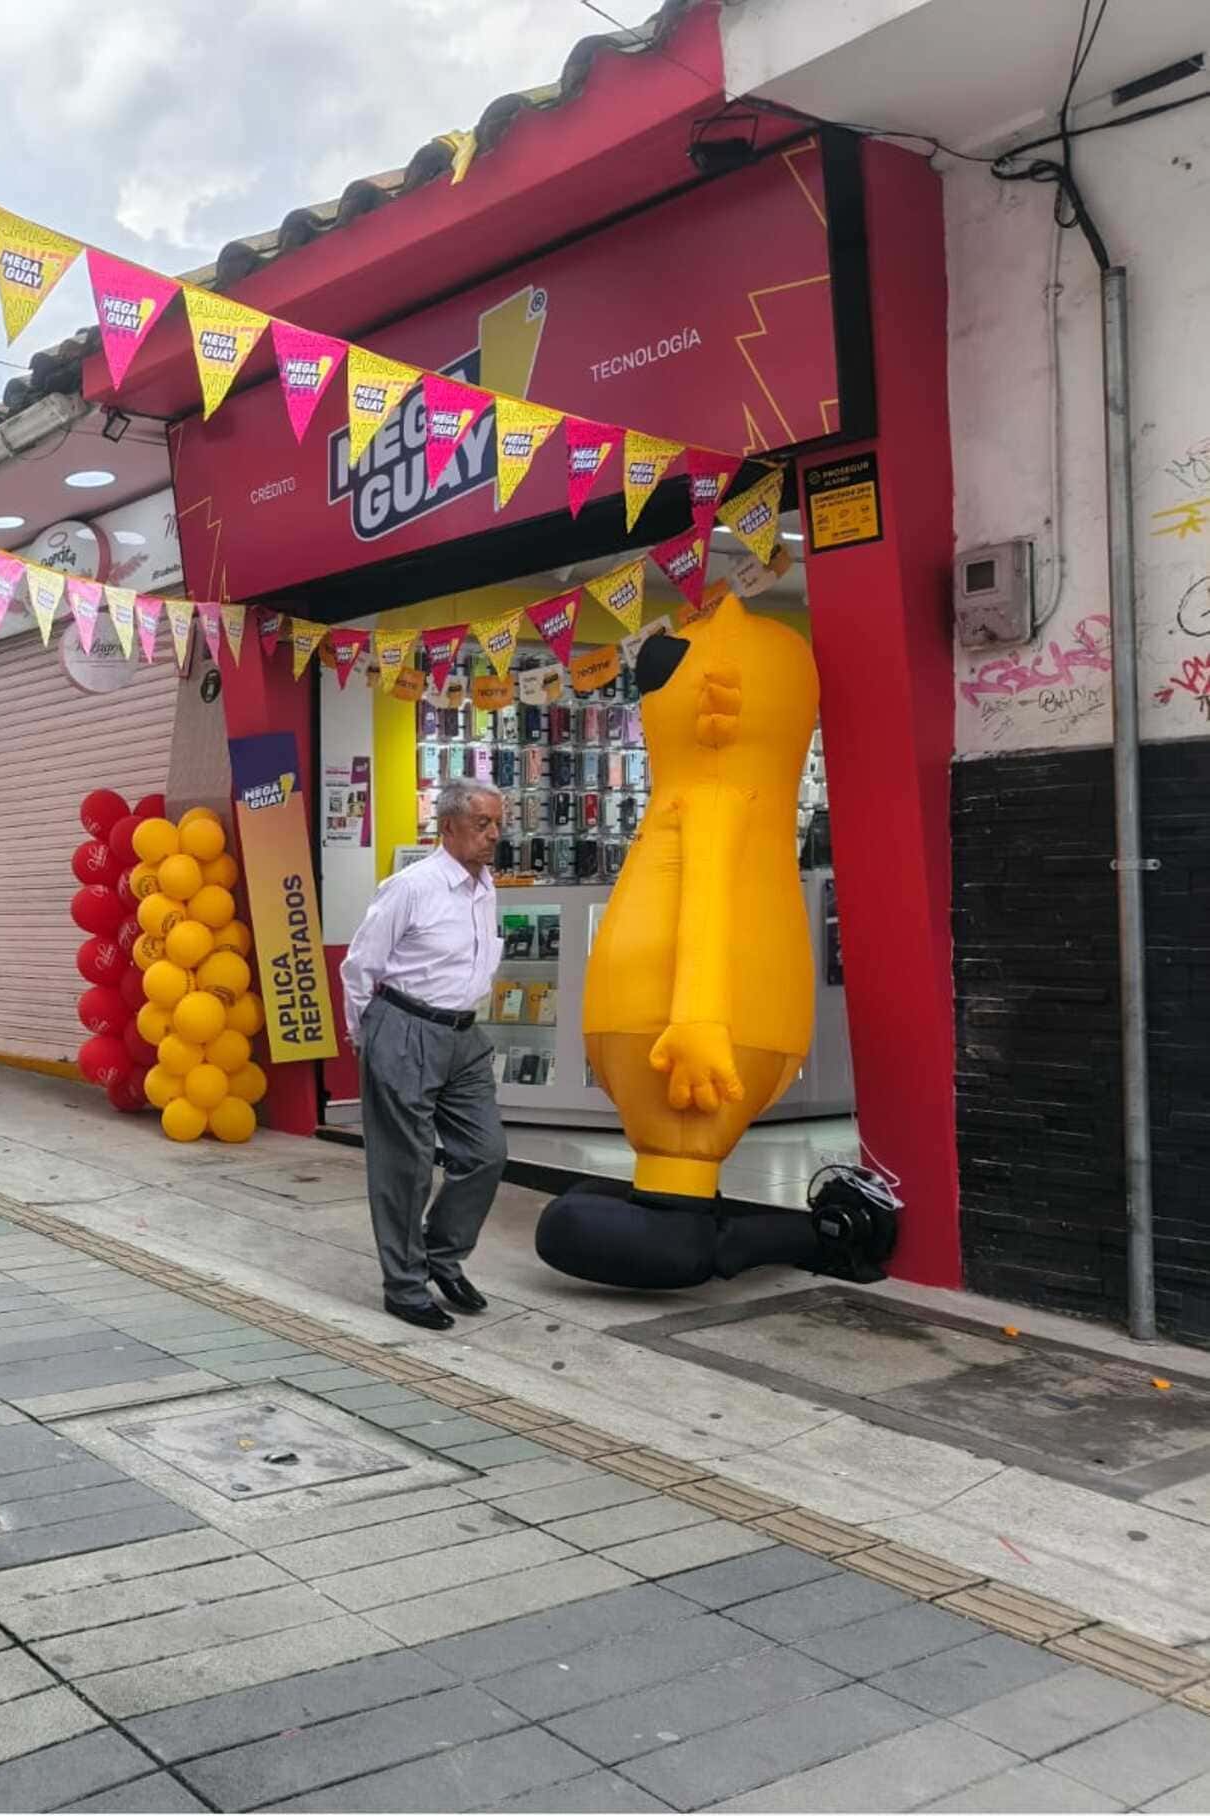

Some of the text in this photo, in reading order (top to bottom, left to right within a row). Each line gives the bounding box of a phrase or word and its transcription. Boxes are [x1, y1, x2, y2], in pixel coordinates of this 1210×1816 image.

[2, 253, 40, 274] MEGA
[5, 268, 42, 288] GUAY
[103, 299, 138, 316] MEGA
[107, 311, 139, 328] GUAY
[201, 333, 235, 348] MEGA
[204, 346, 237, 361] GUAY
[590, 327, 701, 383] TECNOLOGÍA
[286, 361, 318, 375] MEGA
[289, 373, 319, 386] GUAY
[355, 386, 386, 401] MEGA
[356, 398, 384, 412] GUAY
[431, 412, 459, 426] MEGA
[432, 423, 459, 436] GUAY
[503, 434, 532, 447] MEGA
[504, 444, 531, 456] GUAY
[572, 449, 599, 461] MEGA
[572, 458, 598, 471] GUAY
[630, 463, 656, 475] MEGA
[630, 473, 653, 483] GUAY
[694, 477, 718, 489] MEGA
[250, 476, 296, 504] CRÉDITO
[694, 486, 718, 498] GUAY
[738, 503, 768, 527] MEGA
[743, 511, 772, 535] GUAY
[669, 550, 697, 570] MEGA
[674, 558, 700, 579] GUAY
[542, 608, 569, 629] MEGA
[548, 618, 572, 637] GUAY
[244, 784, 279, 802] MEGA
[249, 793, 284, 809] GUAY
[284, 874, 322, 1042] REPORTADOS
[272, 953, 300, 1044] APLICA
